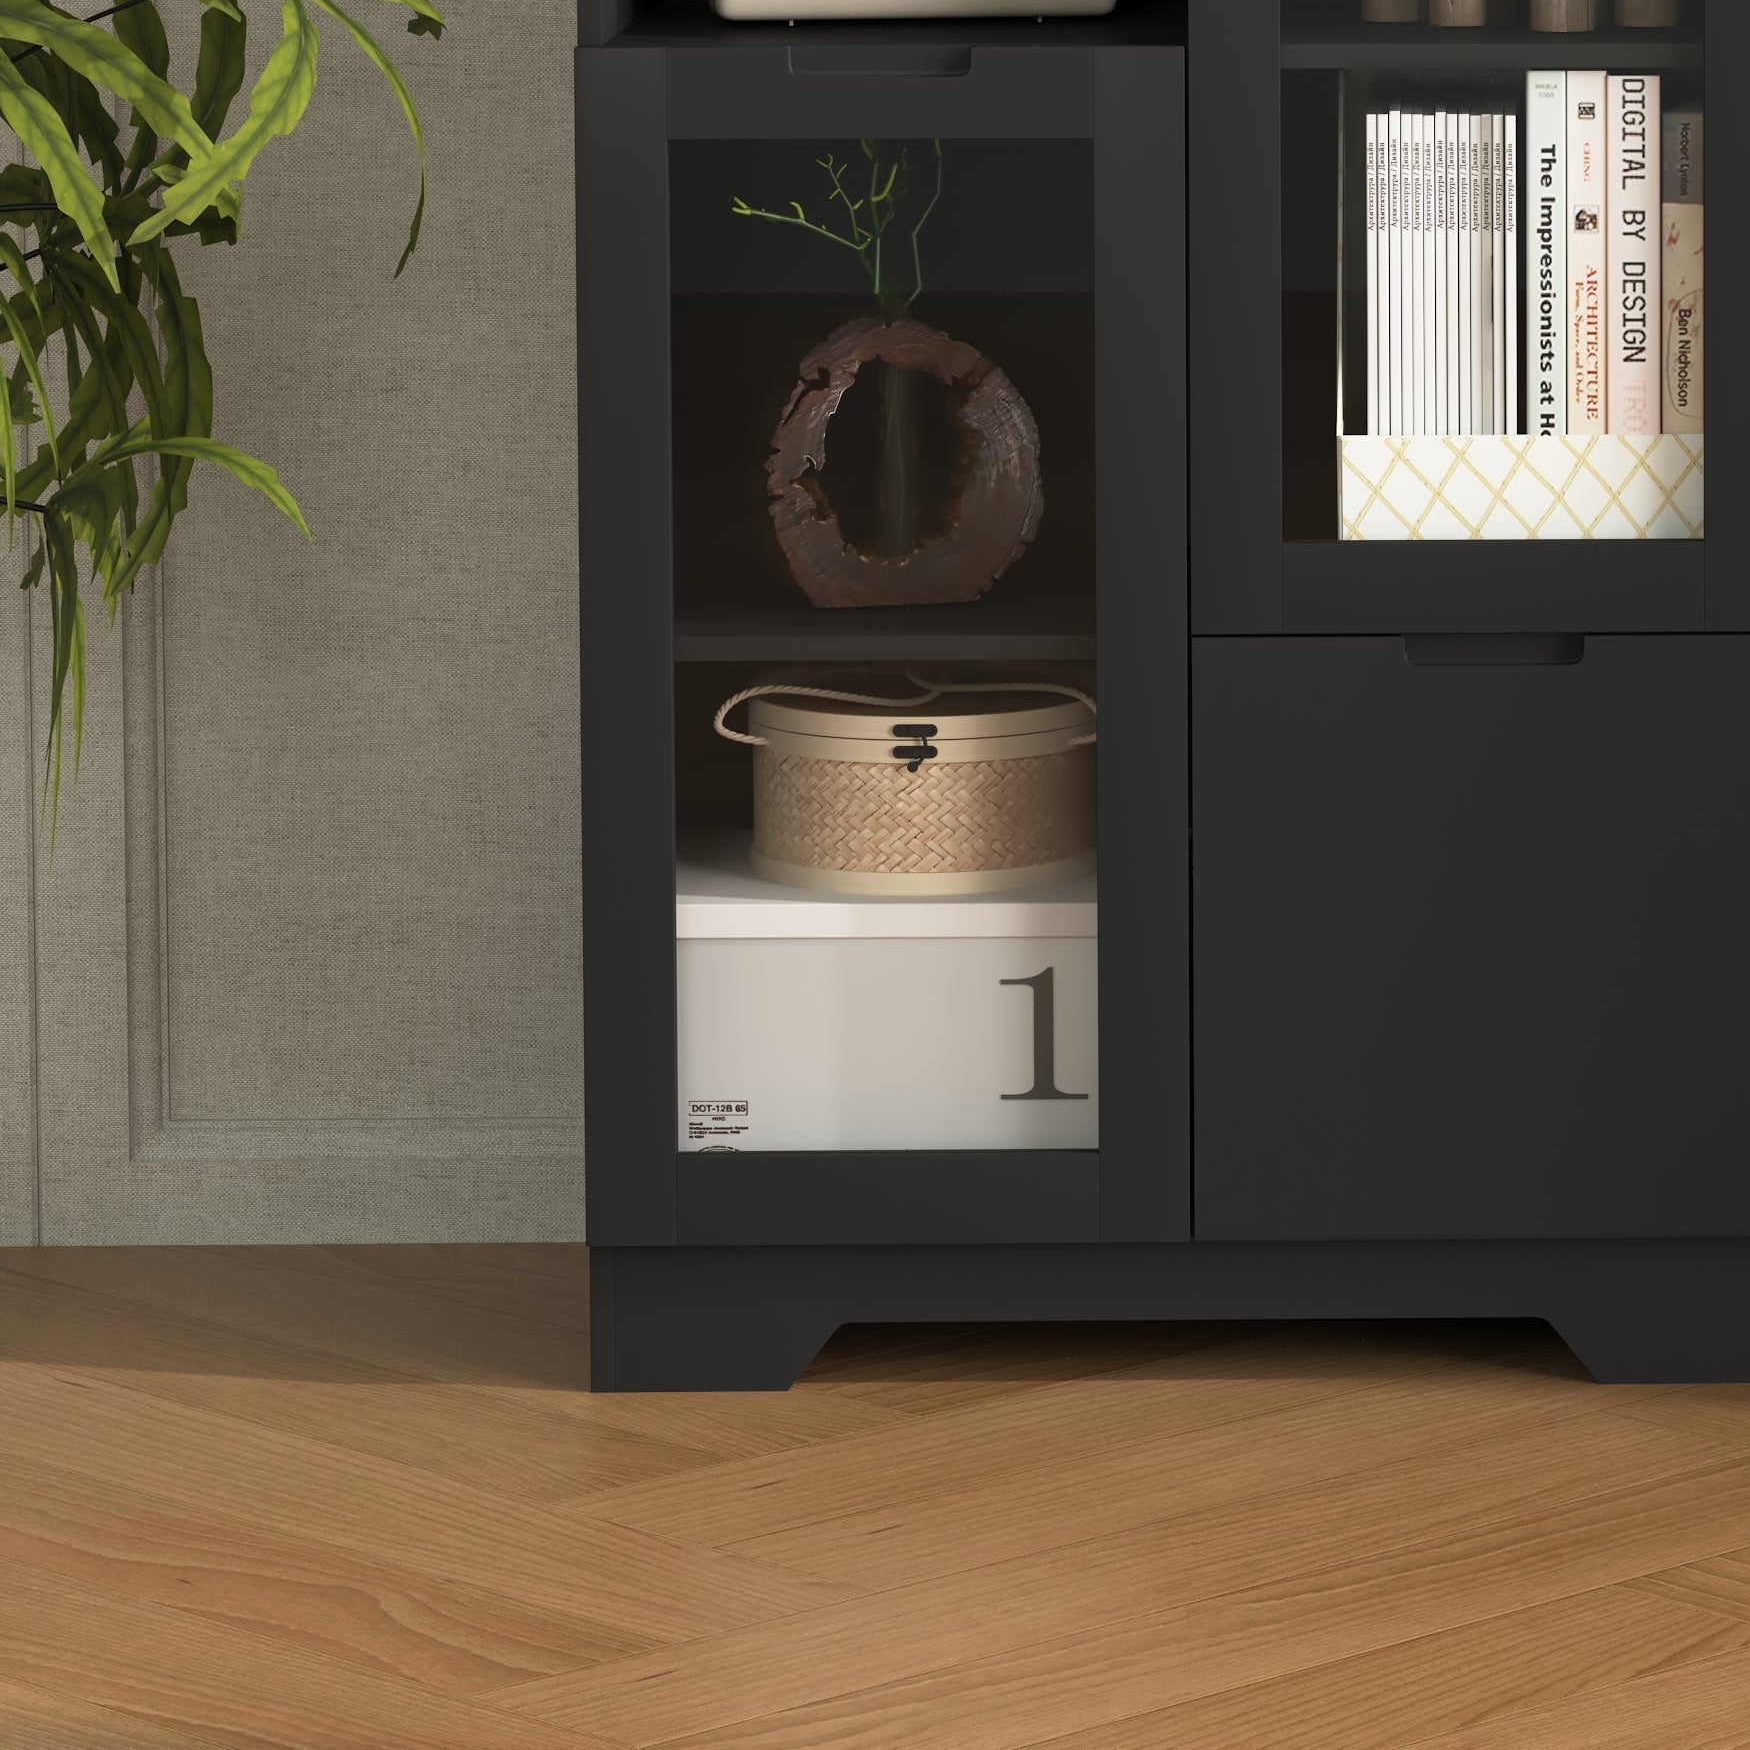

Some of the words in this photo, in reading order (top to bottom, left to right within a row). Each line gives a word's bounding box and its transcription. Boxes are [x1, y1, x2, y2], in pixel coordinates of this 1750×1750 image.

[1622, 78, 1646, 190] DIGITAL
[1540, 144, 1556, 188] The
[1622, 210, 1646, 241] BY
[1537, 198, 1556, 372] Impressionists
[1622, 262, 1646, 362] DESIGN
[1586, 266, 1598, 420] ARCHITECTURE
[1678, 309, 1692, 335] Ben
[1576, 352, 1584, 369] and
[1678, 340, 1692, 407] Nicholson
[1540, 382, 1555, 405] at
[999, 966, 1089, 1100] 1
[692, 1104, 733, 1112] DOT-12B
